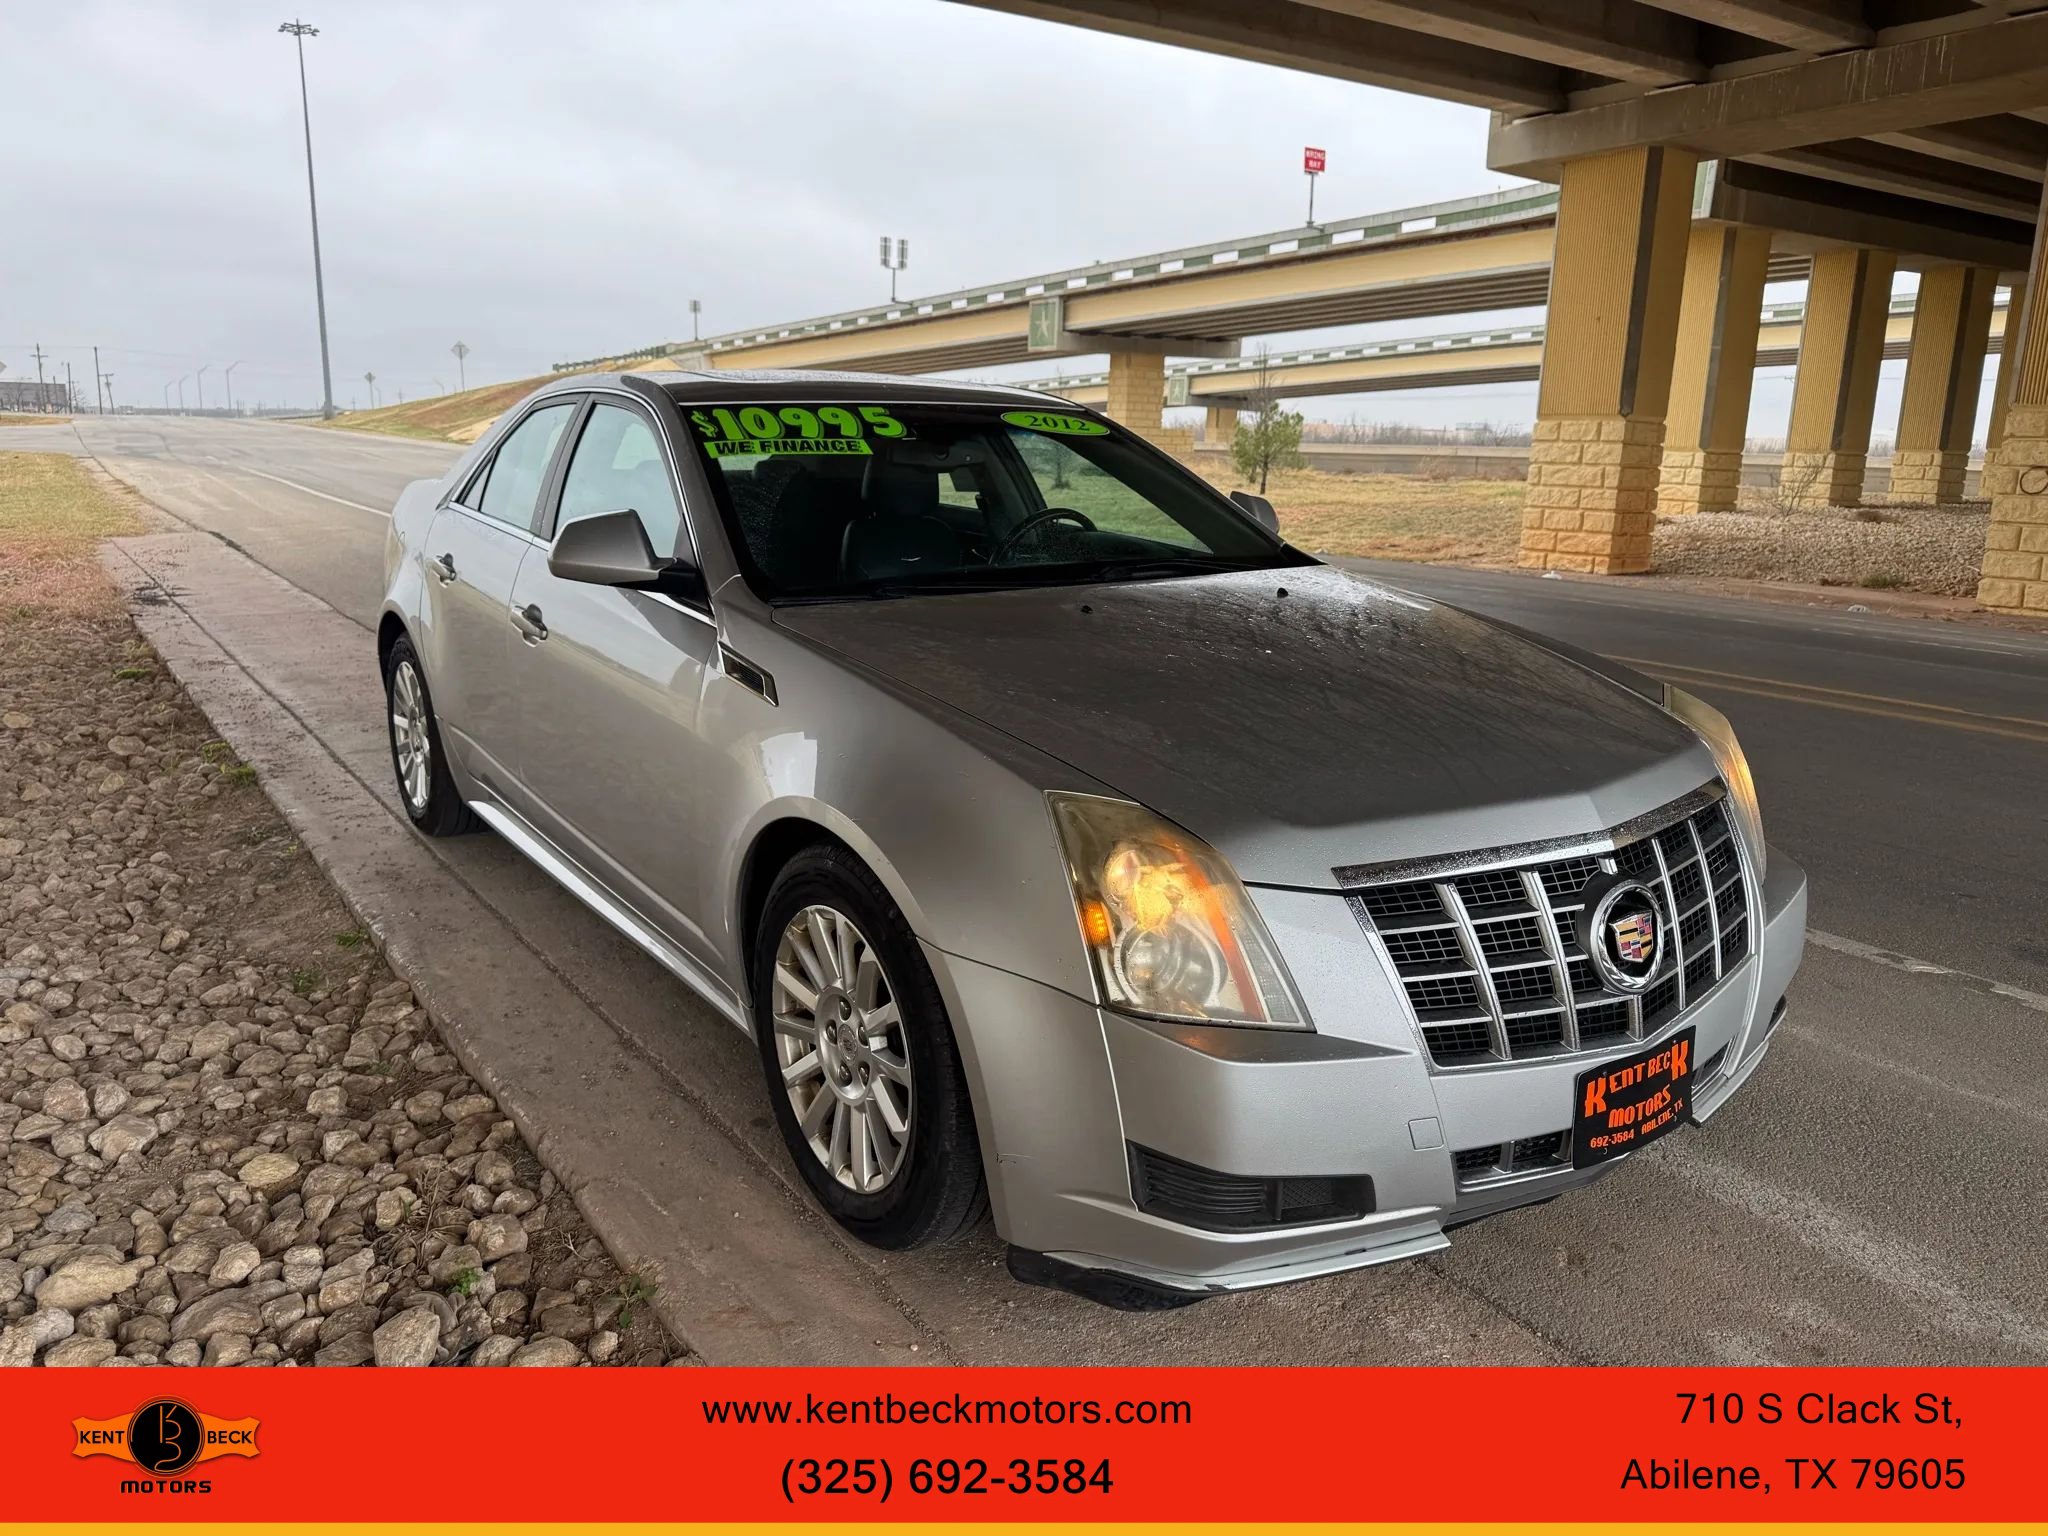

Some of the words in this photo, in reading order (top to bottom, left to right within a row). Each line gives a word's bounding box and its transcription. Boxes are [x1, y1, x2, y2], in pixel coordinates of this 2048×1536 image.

[691, 407, 906, 440] $10995
[1024, 415, 1090, 431] 2012
[717, 440, 753, 455] WE
[759, 439, 860, 454] FINANCE
[1584, 1063, 1645, 1118] KENT
[1647, 1039, 1689, 1081] BECK
[1590, 1128, 1635, 1149] 692-3584
[1641, 1110, 1675, 1135] ABILENE,
[1674, 1098, 1684, 1113] TX
[1608, 1083, 1671, 1129] MOTORS
